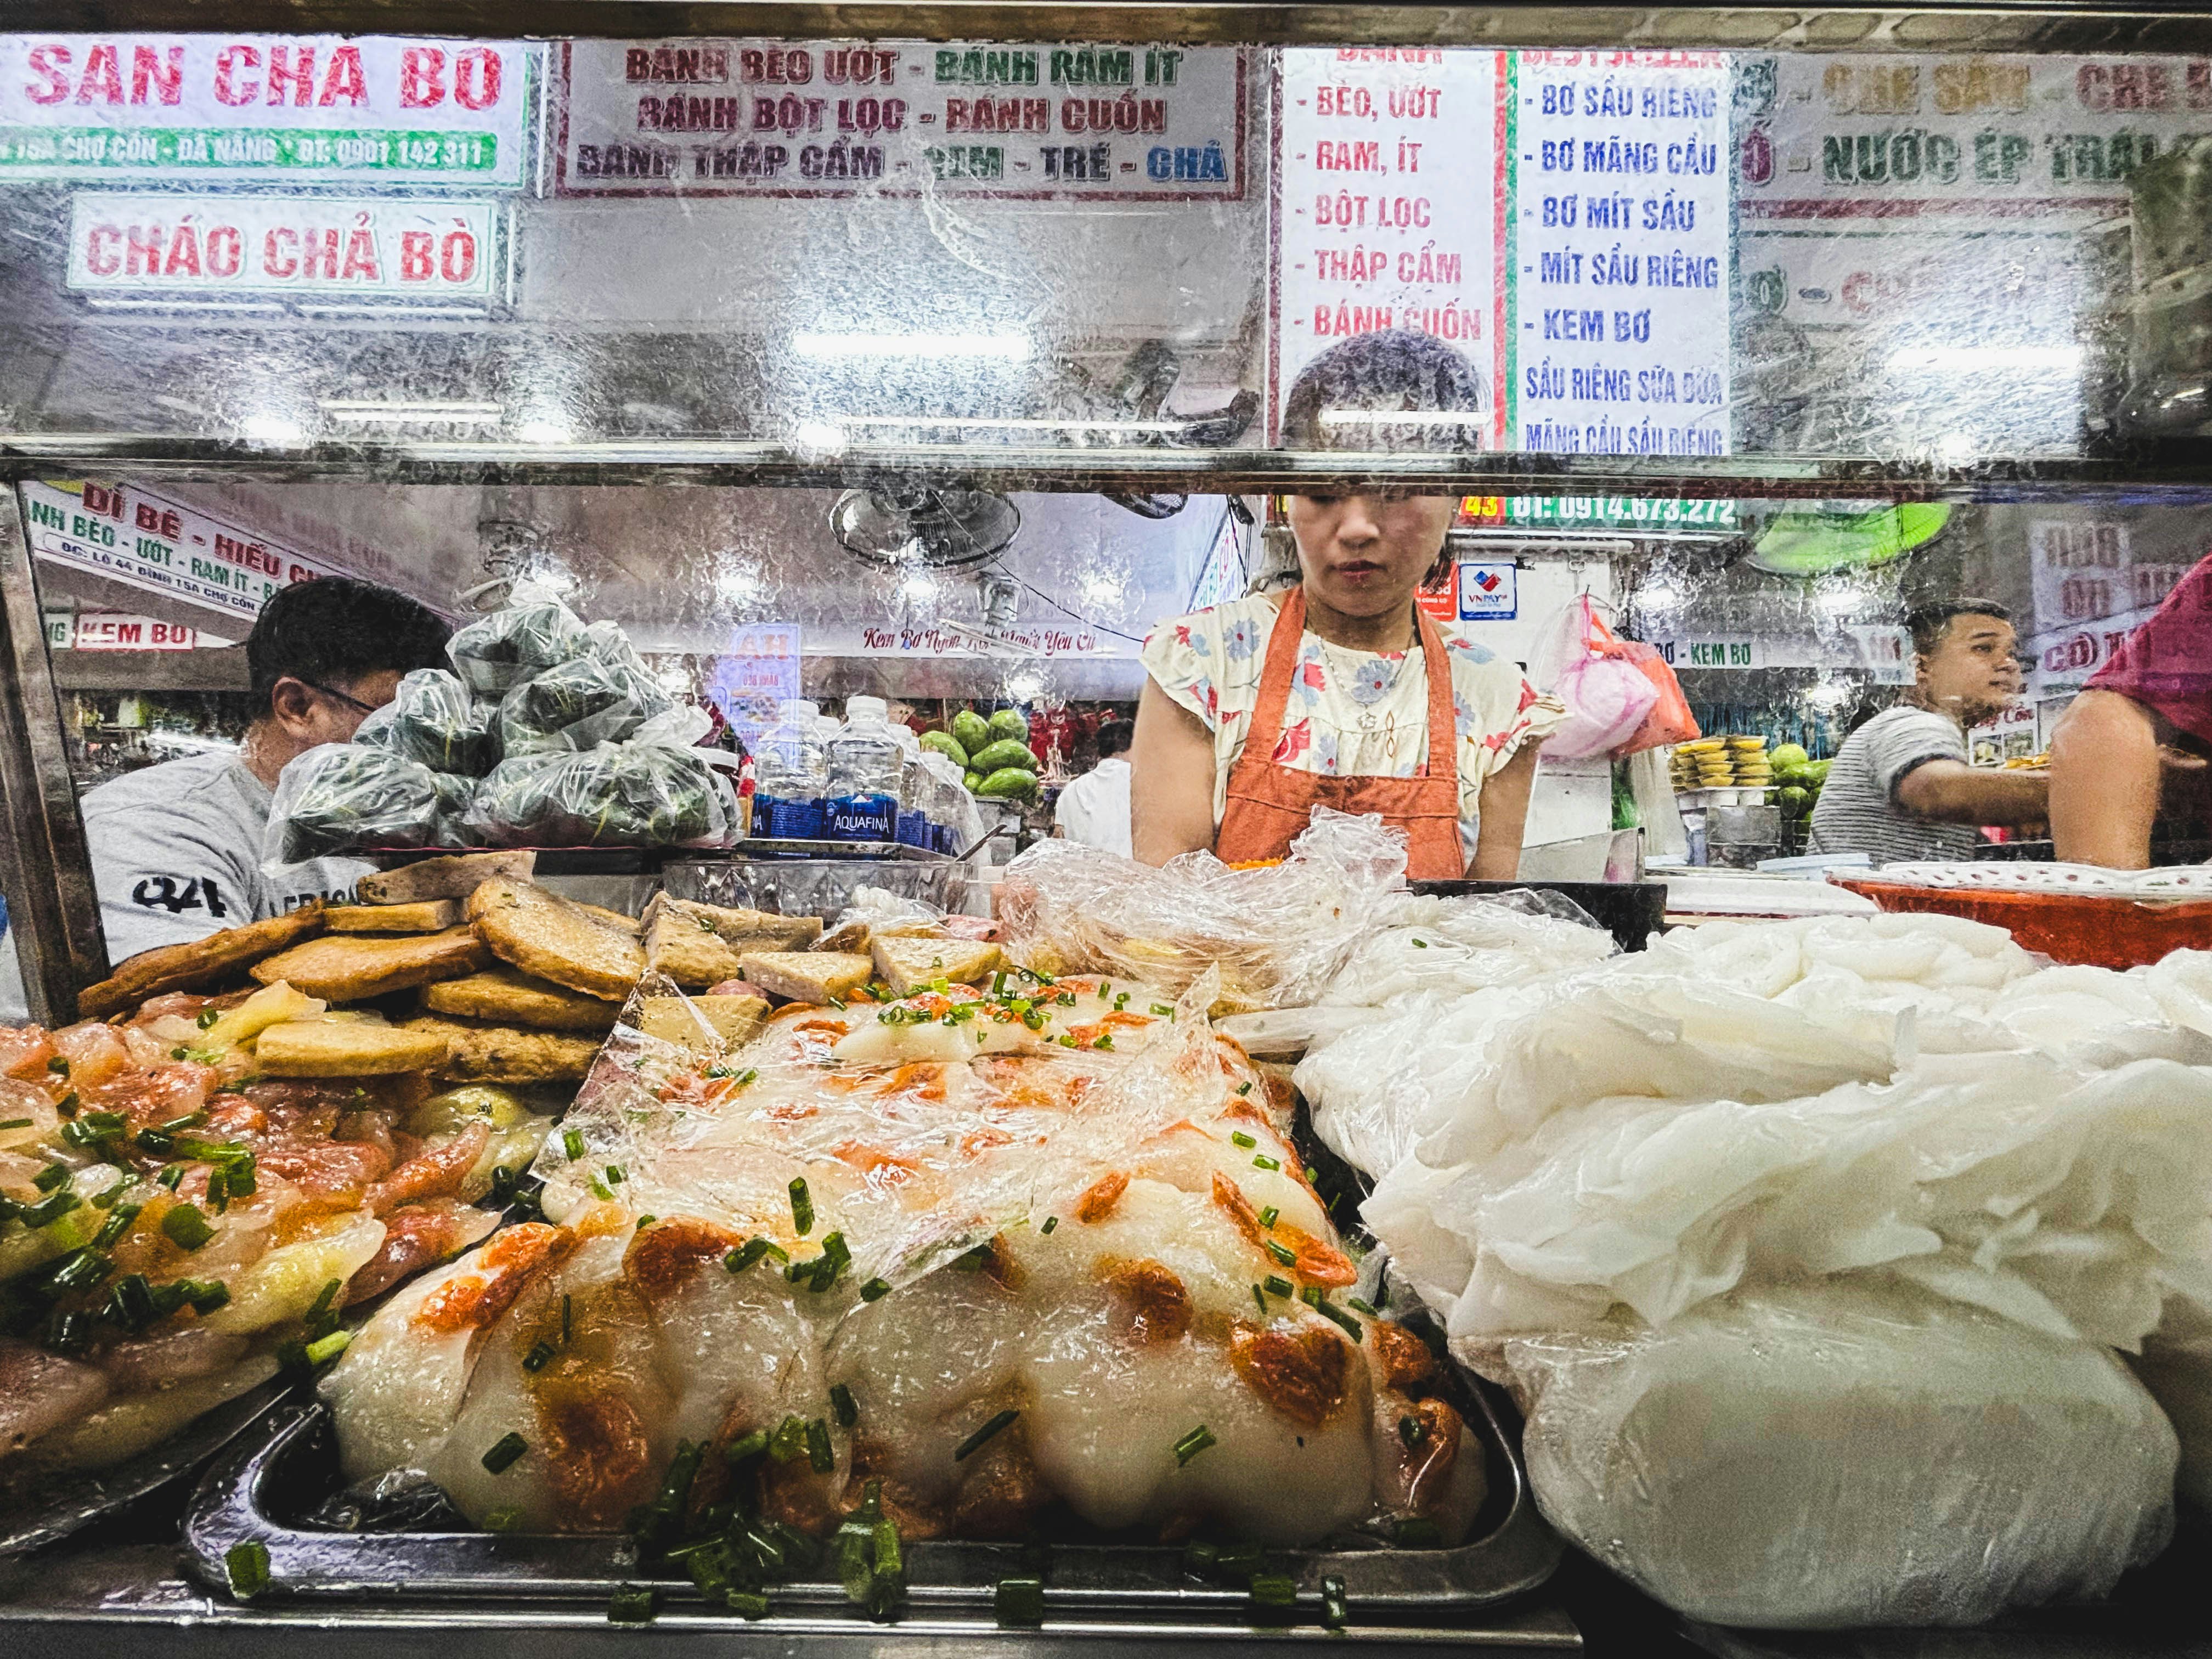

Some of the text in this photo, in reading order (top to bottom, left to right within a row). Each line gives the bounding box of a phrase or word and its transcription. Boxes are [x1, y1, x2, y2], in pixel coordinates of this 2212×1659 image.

[398, 140, 438, 165] 142
[444, 140, 482, 165] 311
[1317, 188, 1431, 235] BỘT LỌC
[1587, 191, 1634, 229] MÍT
[86, 211, 476, 283] CHÁO CHẢ BÒ
[1314, 239, 1461, 289] THẬP CẨM
[1541, 245, 1584, 284] MÍT
[1647, 249, 1718, 288] RIÊNG
[1544, 308, 1651, 343] KEM BƠ
[1572, 362, 1631, 402] RIÊNG
[192, 557, 229, 586] RAM
[864, 627, 896, 649] Kem
[1691, 643, 1725, 665] KEM
[833, 815, 890, 833] AQUAFINA
